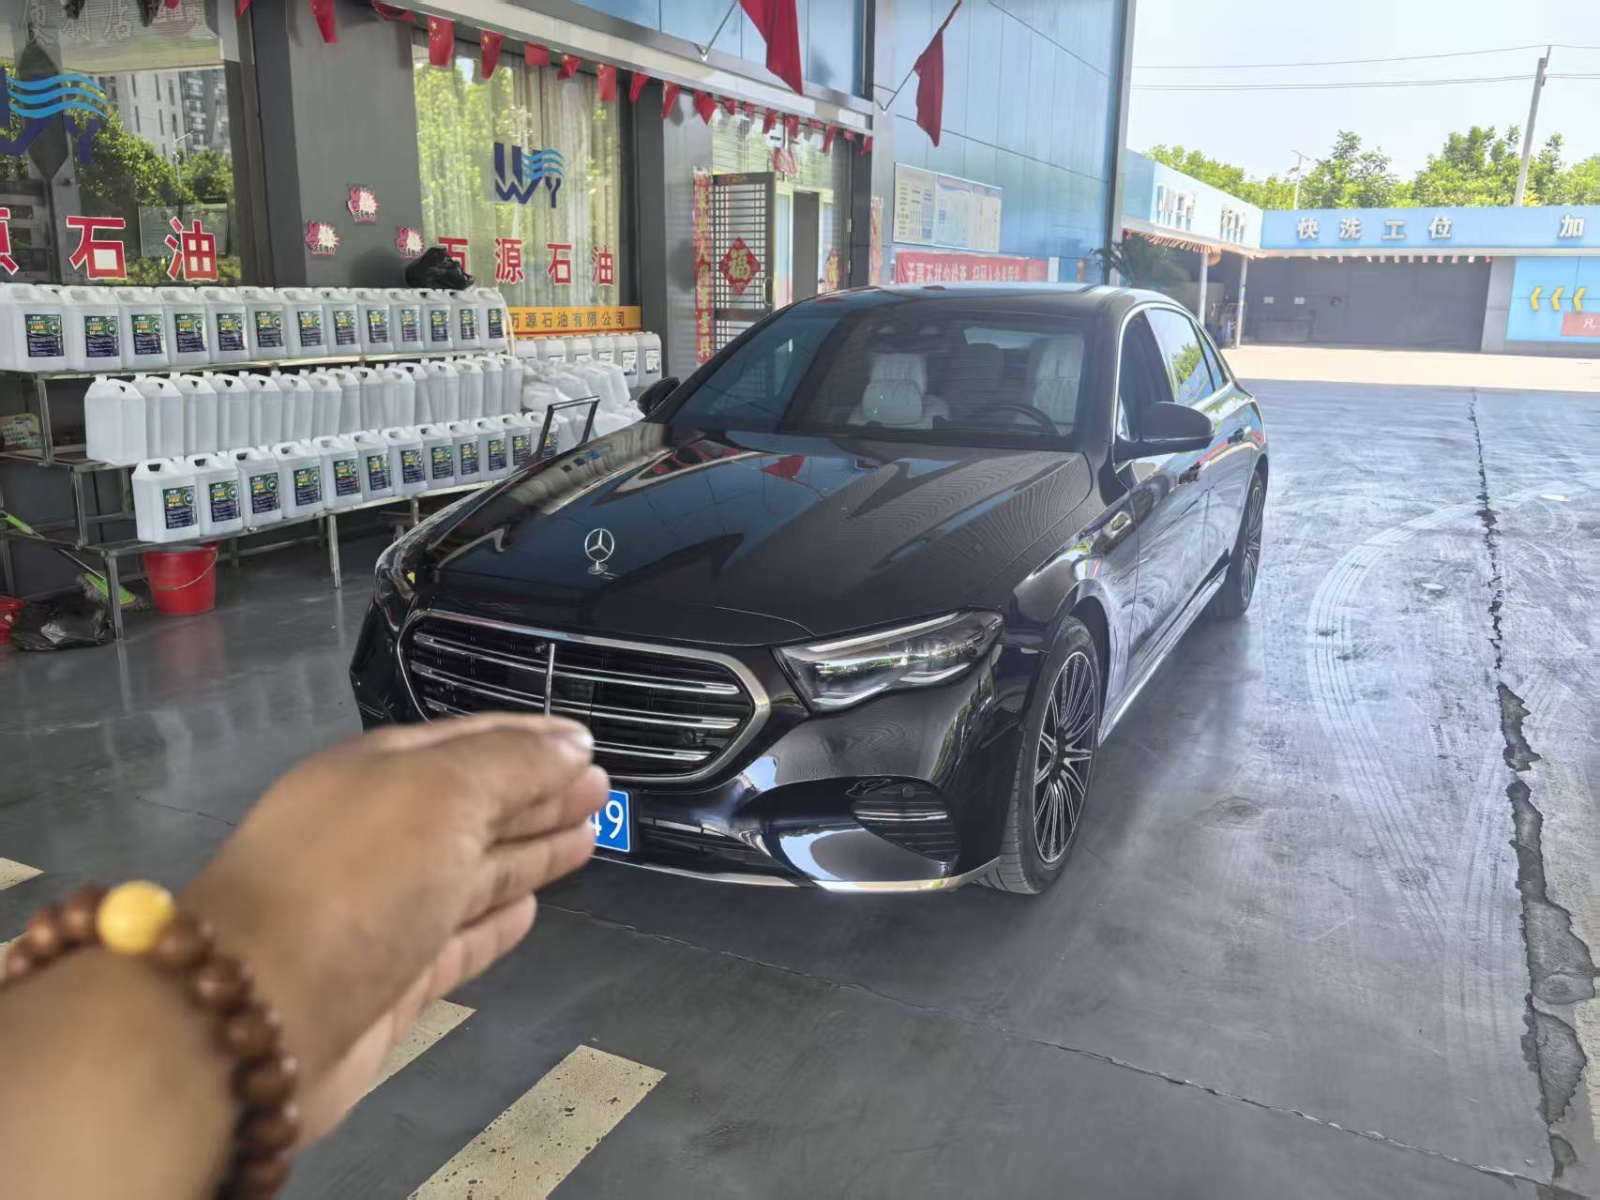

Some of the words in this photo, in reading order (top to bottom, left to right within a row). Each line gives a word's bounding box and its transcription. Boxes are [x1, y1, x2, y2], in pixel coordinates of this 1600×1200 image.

[1296, 217, 1452, 240] 快洗工位
[1559, 216, 1584, 238] 加
[0, 207, 218, 282] 石油
[510, 311, 625, 329] 万源石油有限公司
